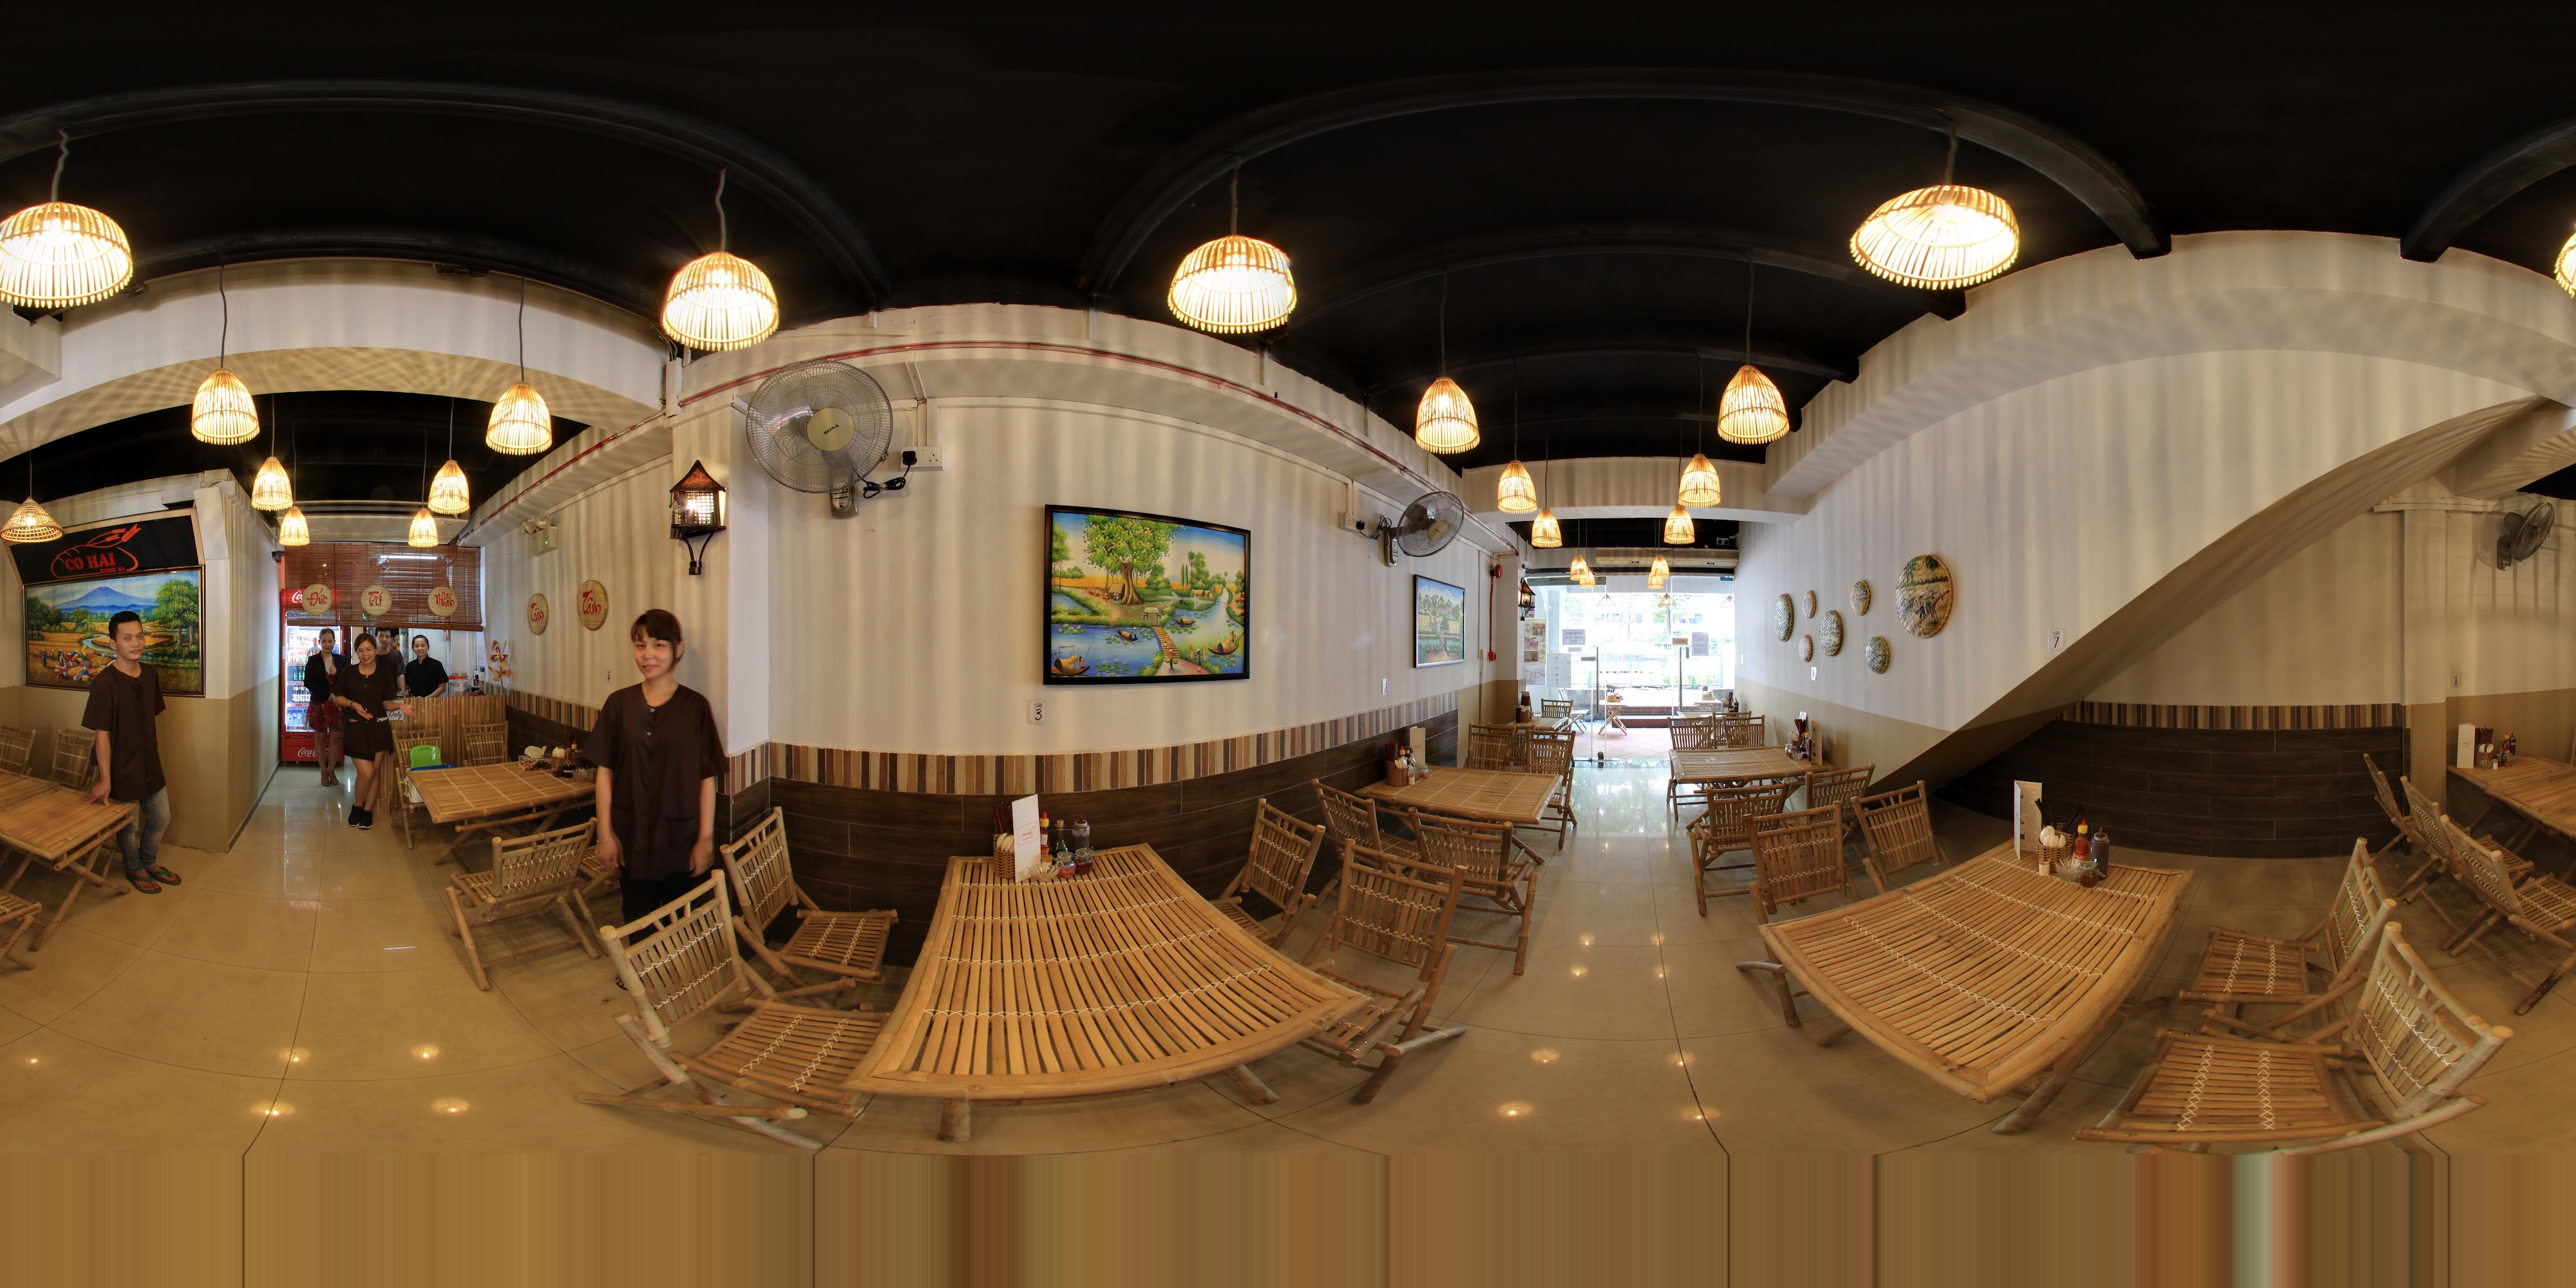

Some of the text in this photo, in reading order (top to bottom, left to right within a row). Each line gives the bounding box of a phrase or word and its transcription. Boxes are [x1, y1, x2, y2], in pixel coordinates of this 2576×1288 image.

[824, 424, 839, 435] SONA
[65, 552, 116, 571] CO HAI
[2054, 636, 2060, 648] 7
[389, 710, 403, 719] Only
[1035, 708, 1042, 721] 3
